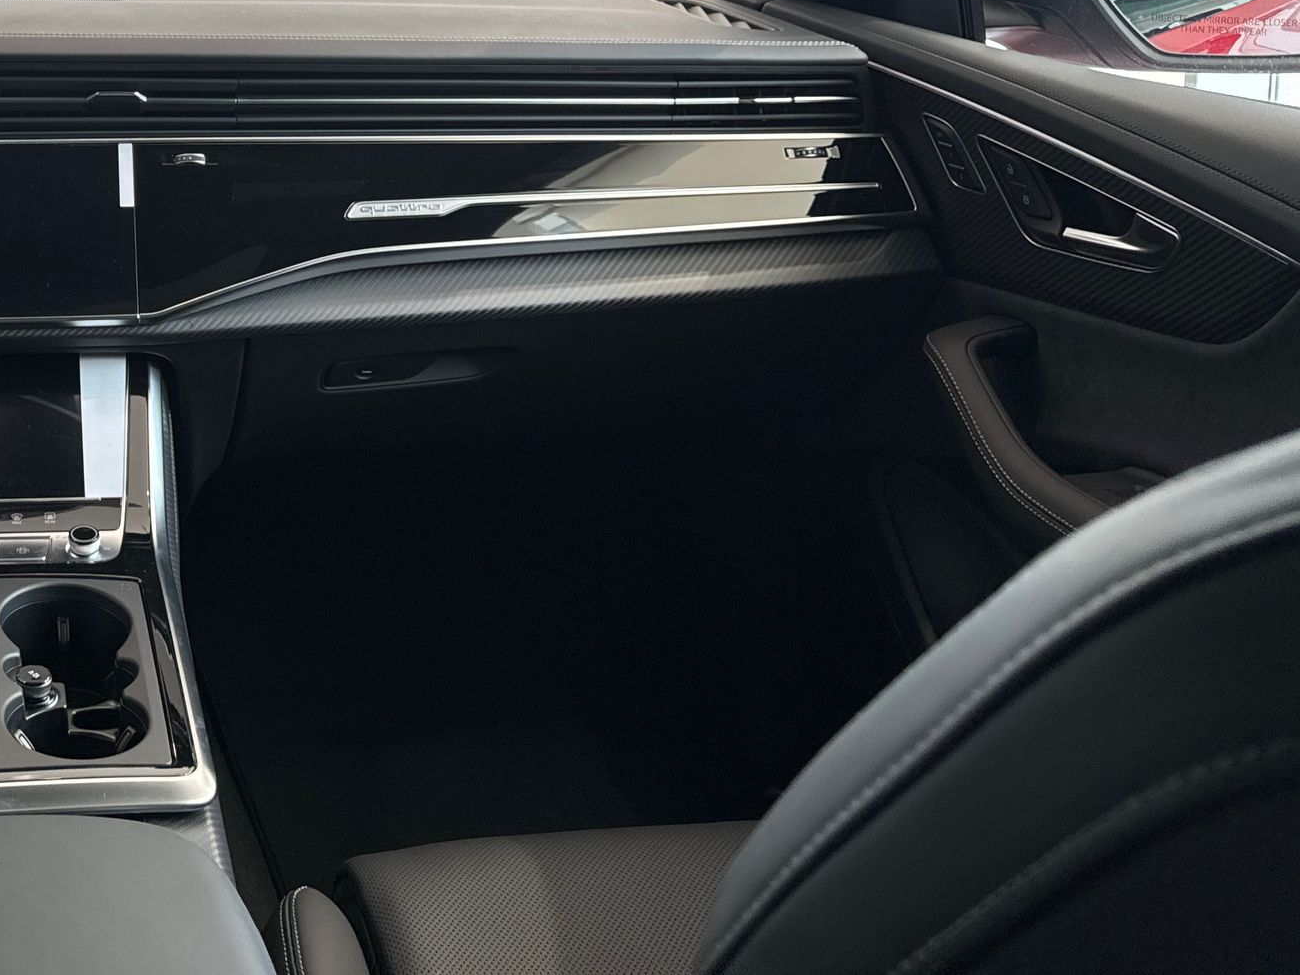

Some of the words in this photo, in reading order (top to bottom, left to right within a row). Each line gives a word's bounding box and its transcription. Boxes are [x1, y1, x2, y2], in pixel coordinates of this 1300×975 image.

[1203, 15, 1240, 25] MIRROR
[1242, 17, 1260, 26] ARE
[1263, 18, 1298, 27] CLOSER
[1180, 25, 1205, 34] THAN
[1207, 26, 1230, 34] THEY
[1232, 27, 1268, 36] APPEAR
[360, 204, 441, 216] quattro
